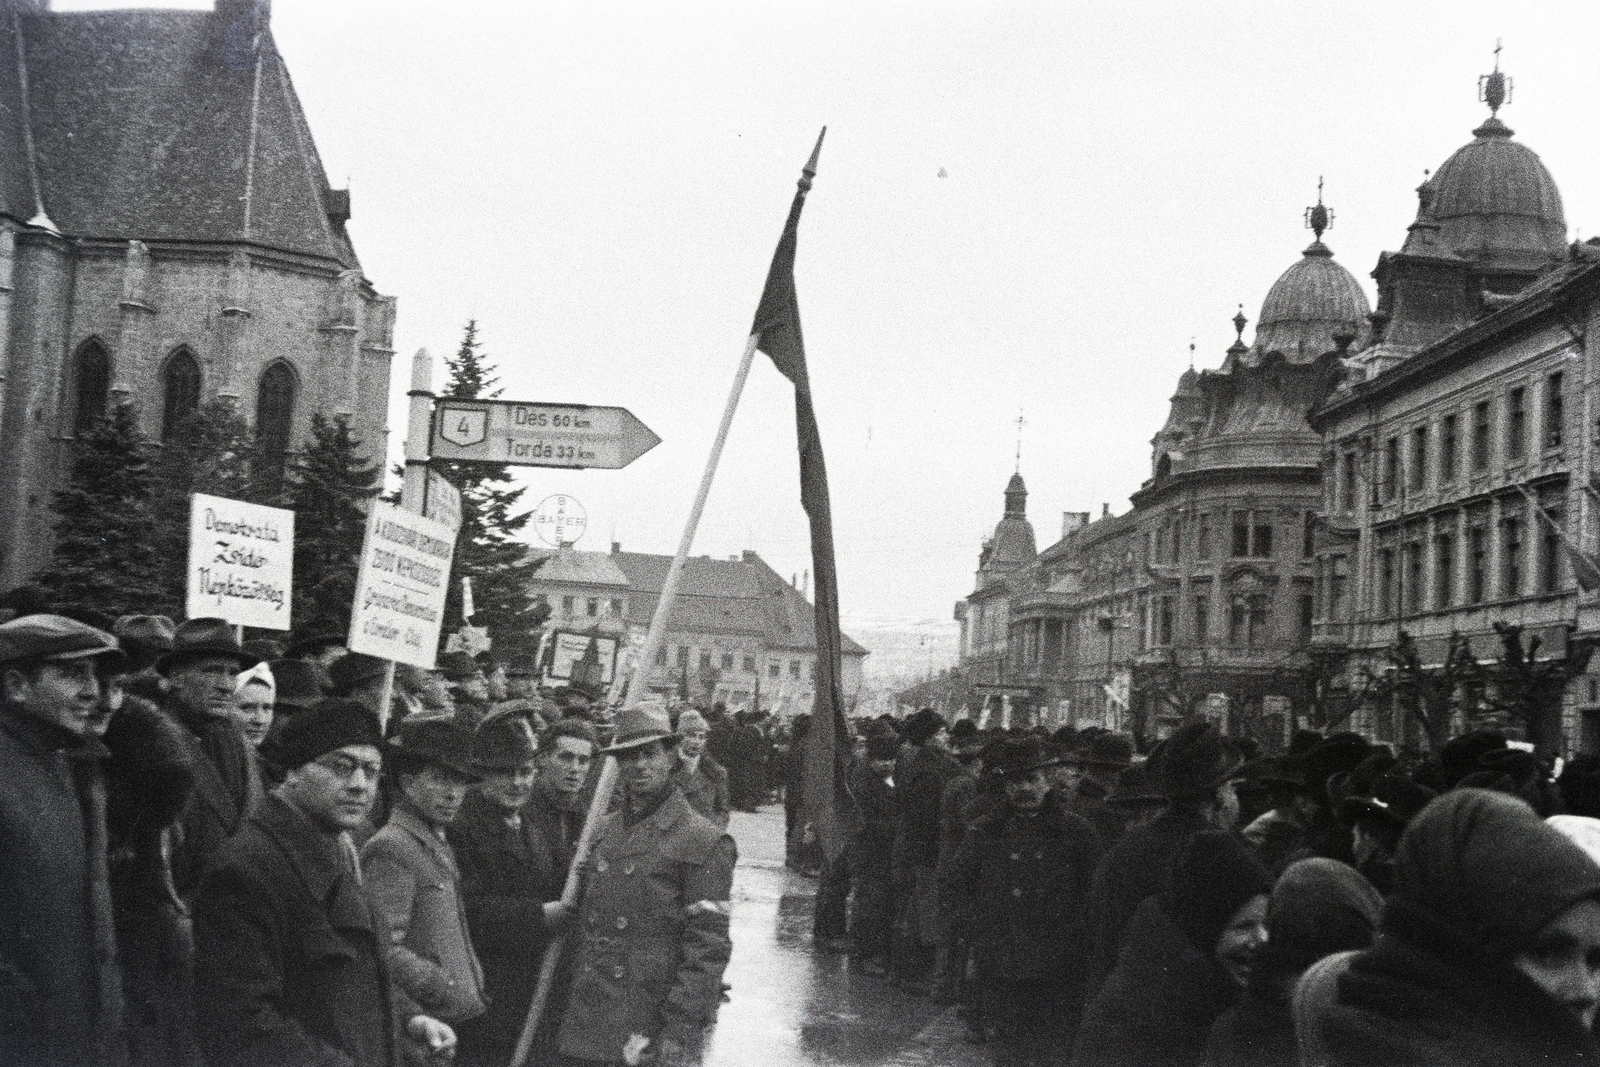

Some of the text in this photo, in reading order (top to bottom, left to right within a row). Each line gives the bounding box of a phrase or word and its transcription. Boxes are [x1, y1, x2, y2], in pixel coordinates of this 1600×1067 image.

[457, 416, 469, 437] 4
[506, 439, 596, 460] Torda 33 km
[539, 515, 585, 526] BAYER
